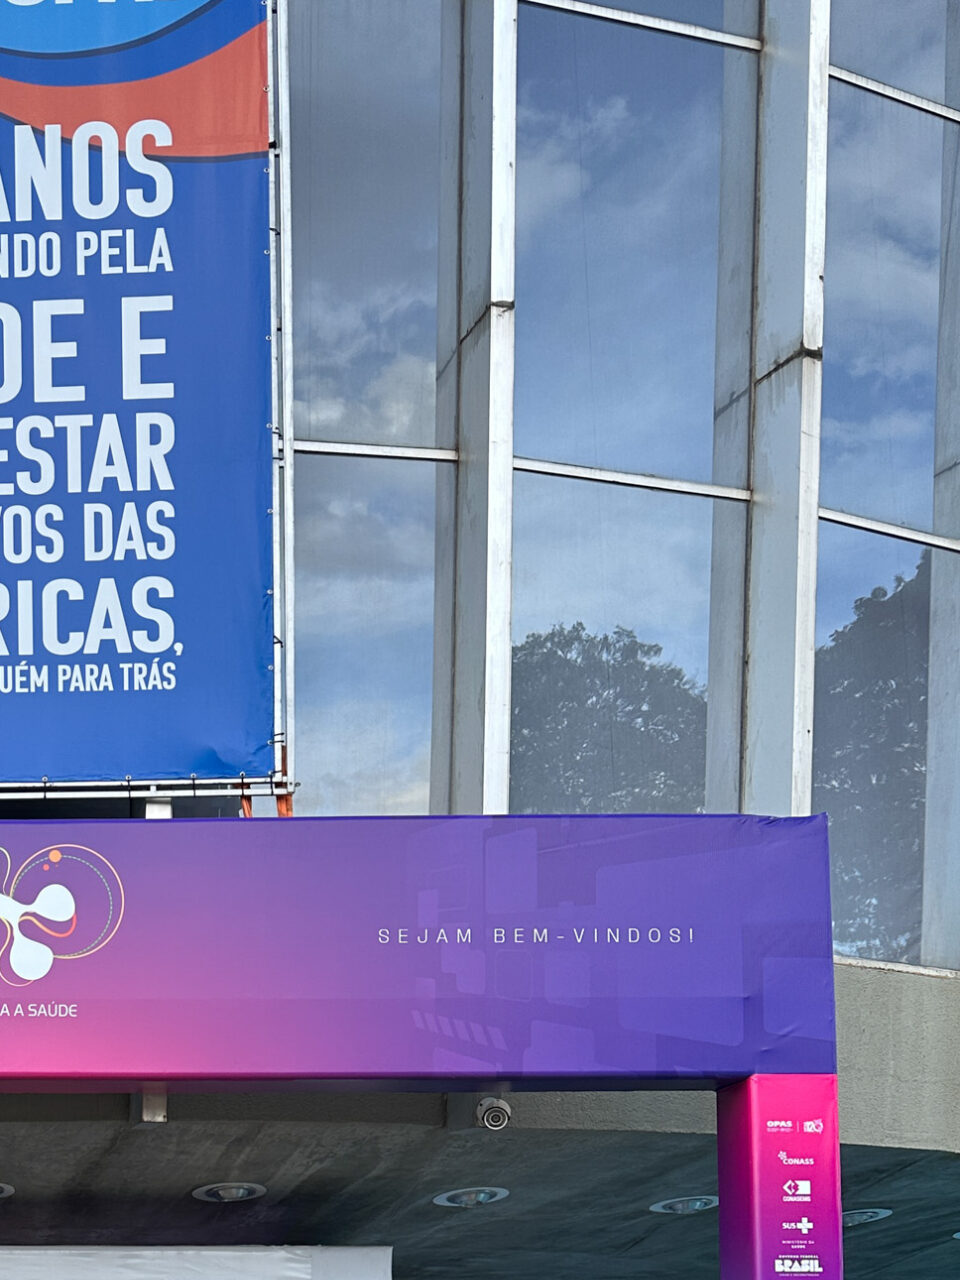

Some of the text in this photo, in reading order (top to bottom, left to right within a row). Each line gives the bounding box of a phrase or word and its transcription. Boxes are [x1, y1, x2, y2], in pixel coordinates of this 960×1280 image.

[76, 227, 174, 276] PELA
[121, 295, 175, 400] E
[84, 501, 176, 562] DAS
[57, 663, 114, 693] PARA
[119, 657, 177, 691] TRÁS
[378, 927, 694, 944] SEJAM BEM-VINDOS!
[13, 1003, 25, 1017] A
[27, 1001, 78, 1018] SAÚDE
[766, 1120, 793, 1128] OPAS
[782, 1222, 797, 1230] SUS
[774, 1259, 823, 1273] BRASIL
